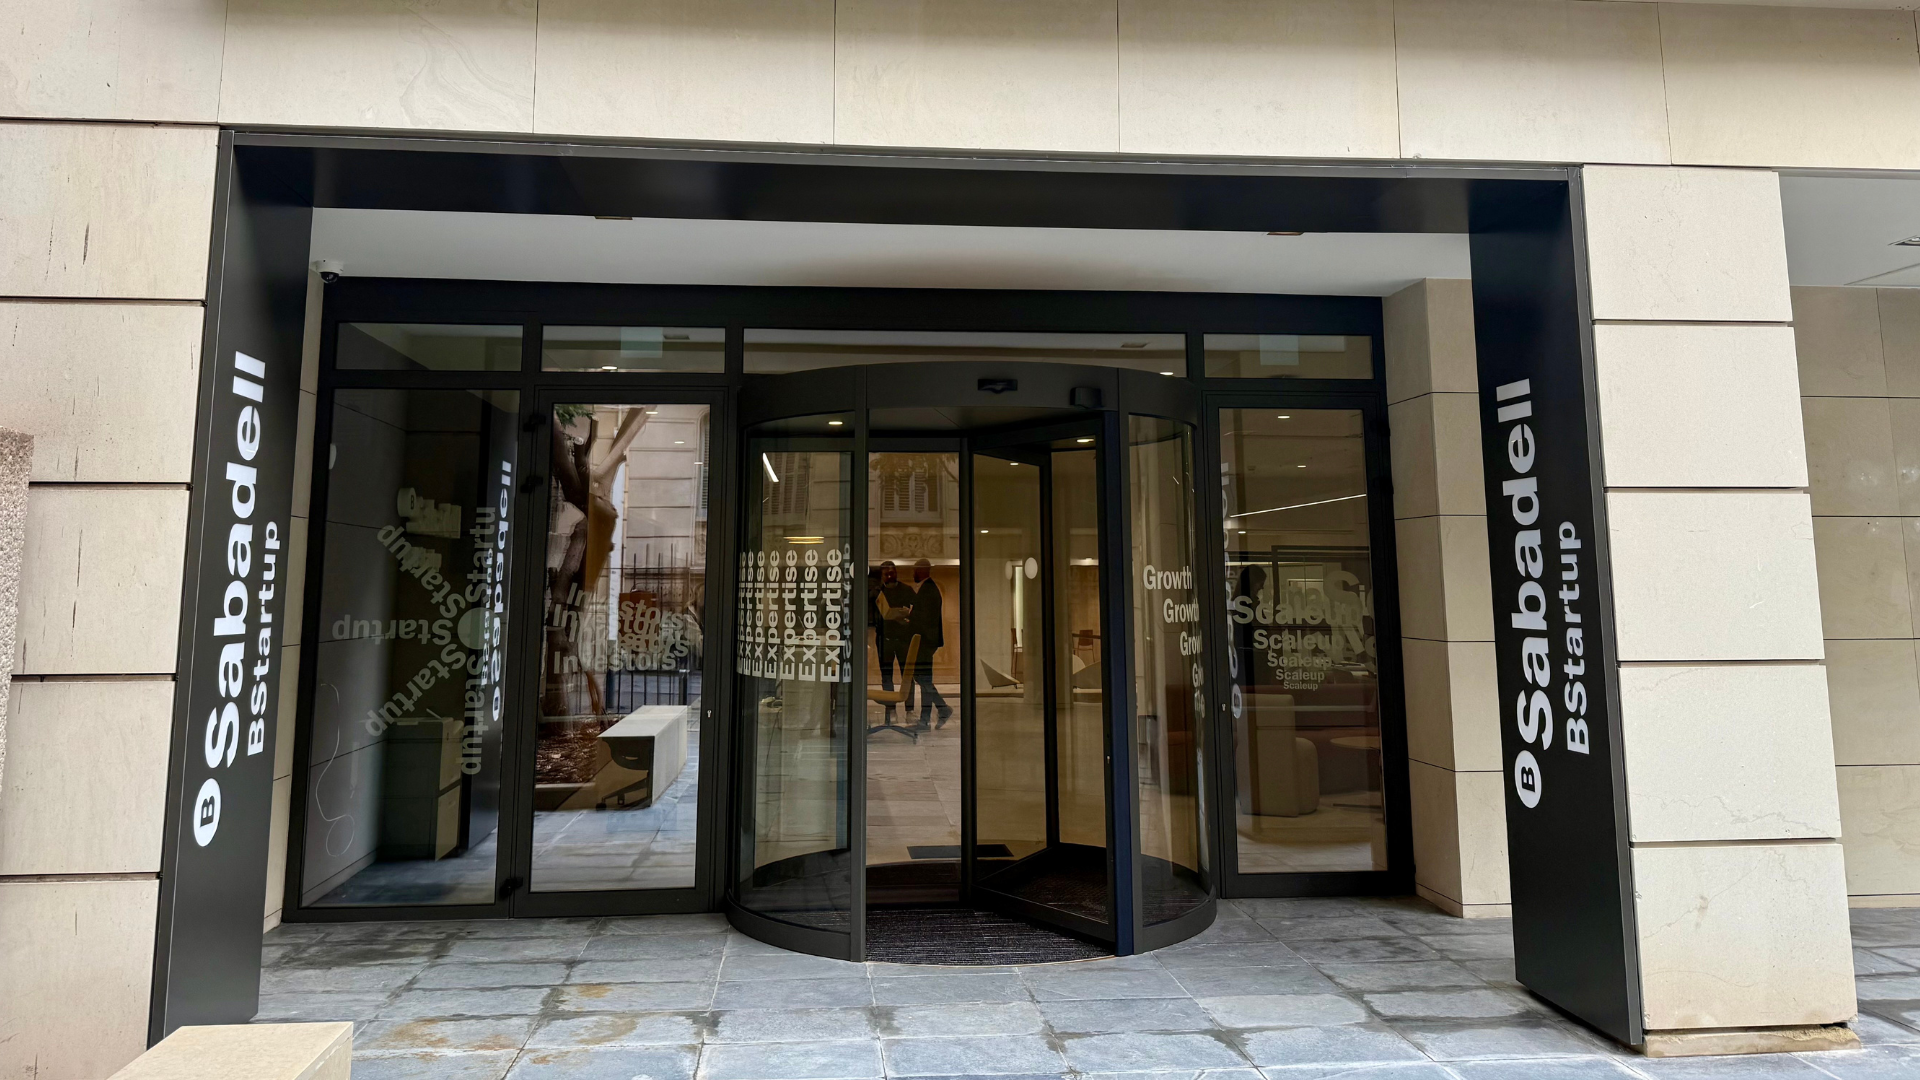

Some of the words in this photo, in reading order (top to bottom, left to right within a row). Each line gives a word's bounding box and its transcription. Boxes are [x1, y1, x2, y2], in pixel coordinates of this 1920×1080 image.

[204, 350, 266, 769] Sabadell
[377, 523, 466, 618] Startup
[752, 550, 766, 678] Expertise
[764, 550, 781, 679] Expertise
[780, 550, 800, 681] Expertise
[798, 549, 821, 682] Expertise
[820, 549, 846, 683] Expertise
[1143, 564, 1193, 590] Growth
[1496, 378, 1553, 751] Sabadell
[247, 520, 280, 757] BStartup
[331, 614, 454, 645] Startup
[363, 645, 467, 737] Startup
[1253, 628, 1346, 656] Scaleup
[1275, 668, 1325, 683] Scaleup
[1283, 681, 1319, 692] Scaleup
[1558, 521, 1590, 755] BStartup
[460, 653, 490, 776] Startup
